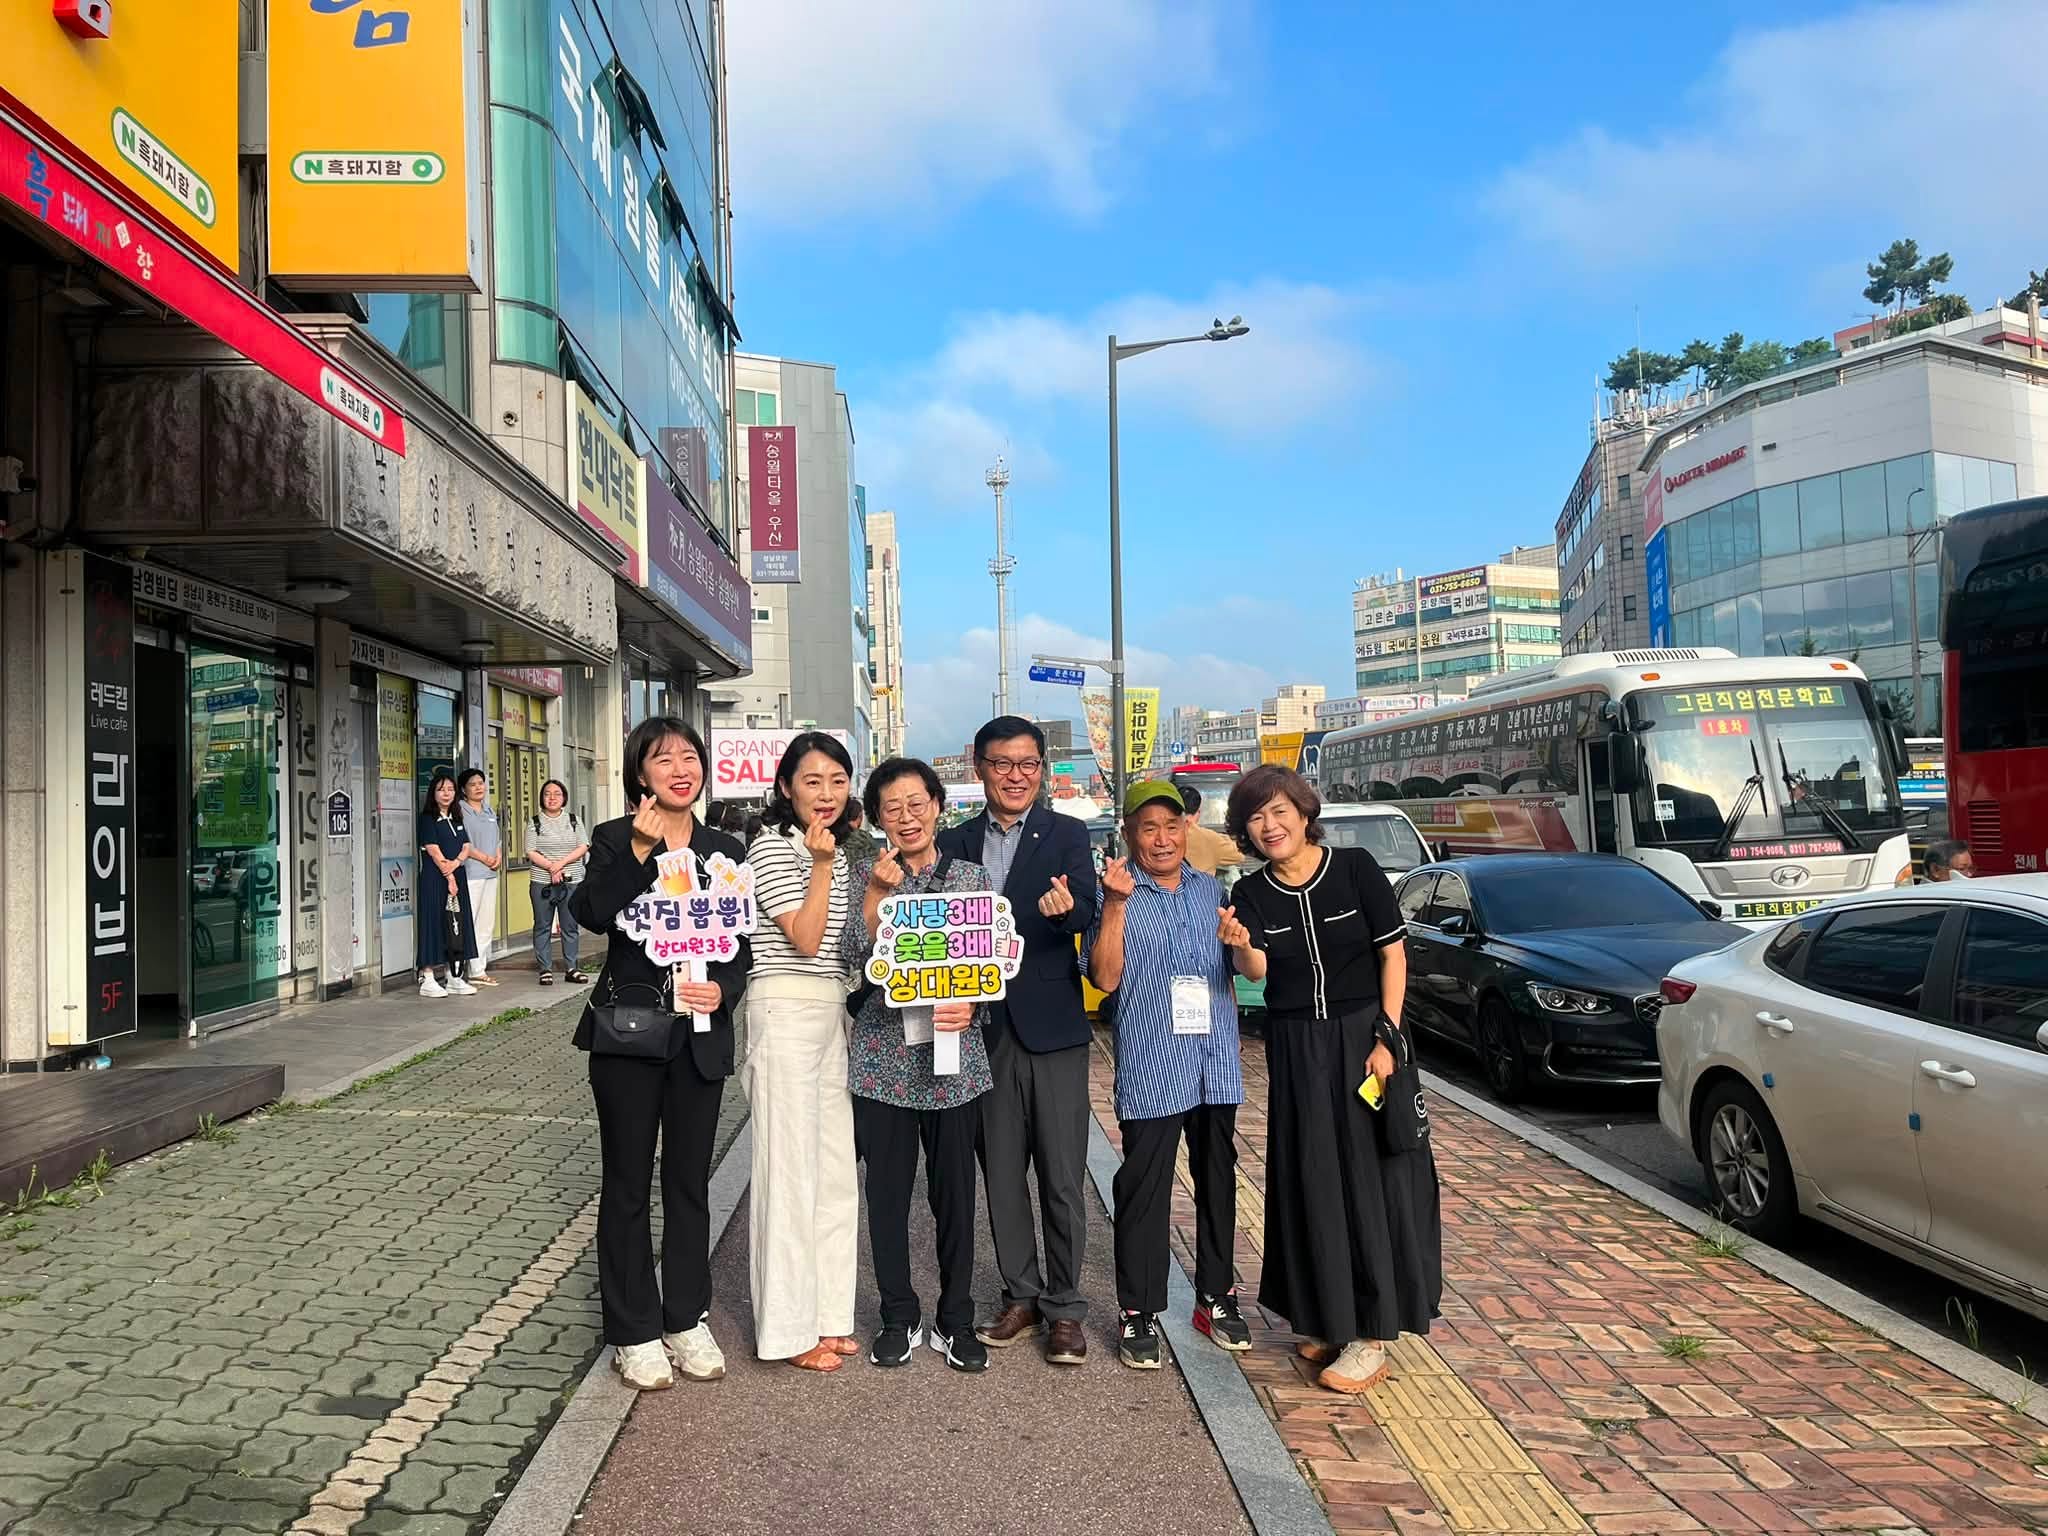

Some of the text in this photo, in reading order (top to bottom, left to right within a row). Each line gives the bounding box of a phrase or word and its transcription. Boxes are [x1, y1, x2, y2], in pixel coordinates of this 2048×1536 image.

[138, 137, 190, 200] 흑돼지함
[326, 159, 402, 176] 흑돼지함
[668, 254, 698, 363] 사무실
[338, 386, 370, 424] 흑돼지함
[577, 406, 637, 528] 현대닥트
[183, 581, 204, 603] 성남시
[206, 589, 227, 609] 중원구
[229, 596, 254, 617] 둔촌대로
[1365, 610, 1394, 626] 고은손
[351, 640, 385, 666] 가자인력
[1356, 626, 1488, 657] 에듀원 국비교육원 국비무료교육
[1676, 686, 1835, 713] 그린직업전문학교
[91, 712, 128, 732] Live cafe
[1446, 713, 1500, 738] 자동차정비
[1706, 720, 1744, 735] 1호차
[718, 740, 788, 757] GRAND
[1399, 725, 1439, 746] 조경시공
[332, 813, 348, 832] 106
[92, 751, 128, 958] 라이브
[1731, 847, 1747, 857] 031)
[1790, 843, 1806, 854] 031)
[2014, 854, 2037, 870] 전세
[623, 896, 751, 933] 멋짐 뿜뿜!
[891, 898, 993, 930] 사랑3배
[654, 935, 732, 958] 상대원3동
[893, 930, 993, 963] 웃음3배
[101, 980, 124, 1012] 5F
[887, 965, 1000, 1002] 상대원3
[1175, 1007, 1207, 1020] 오정식
